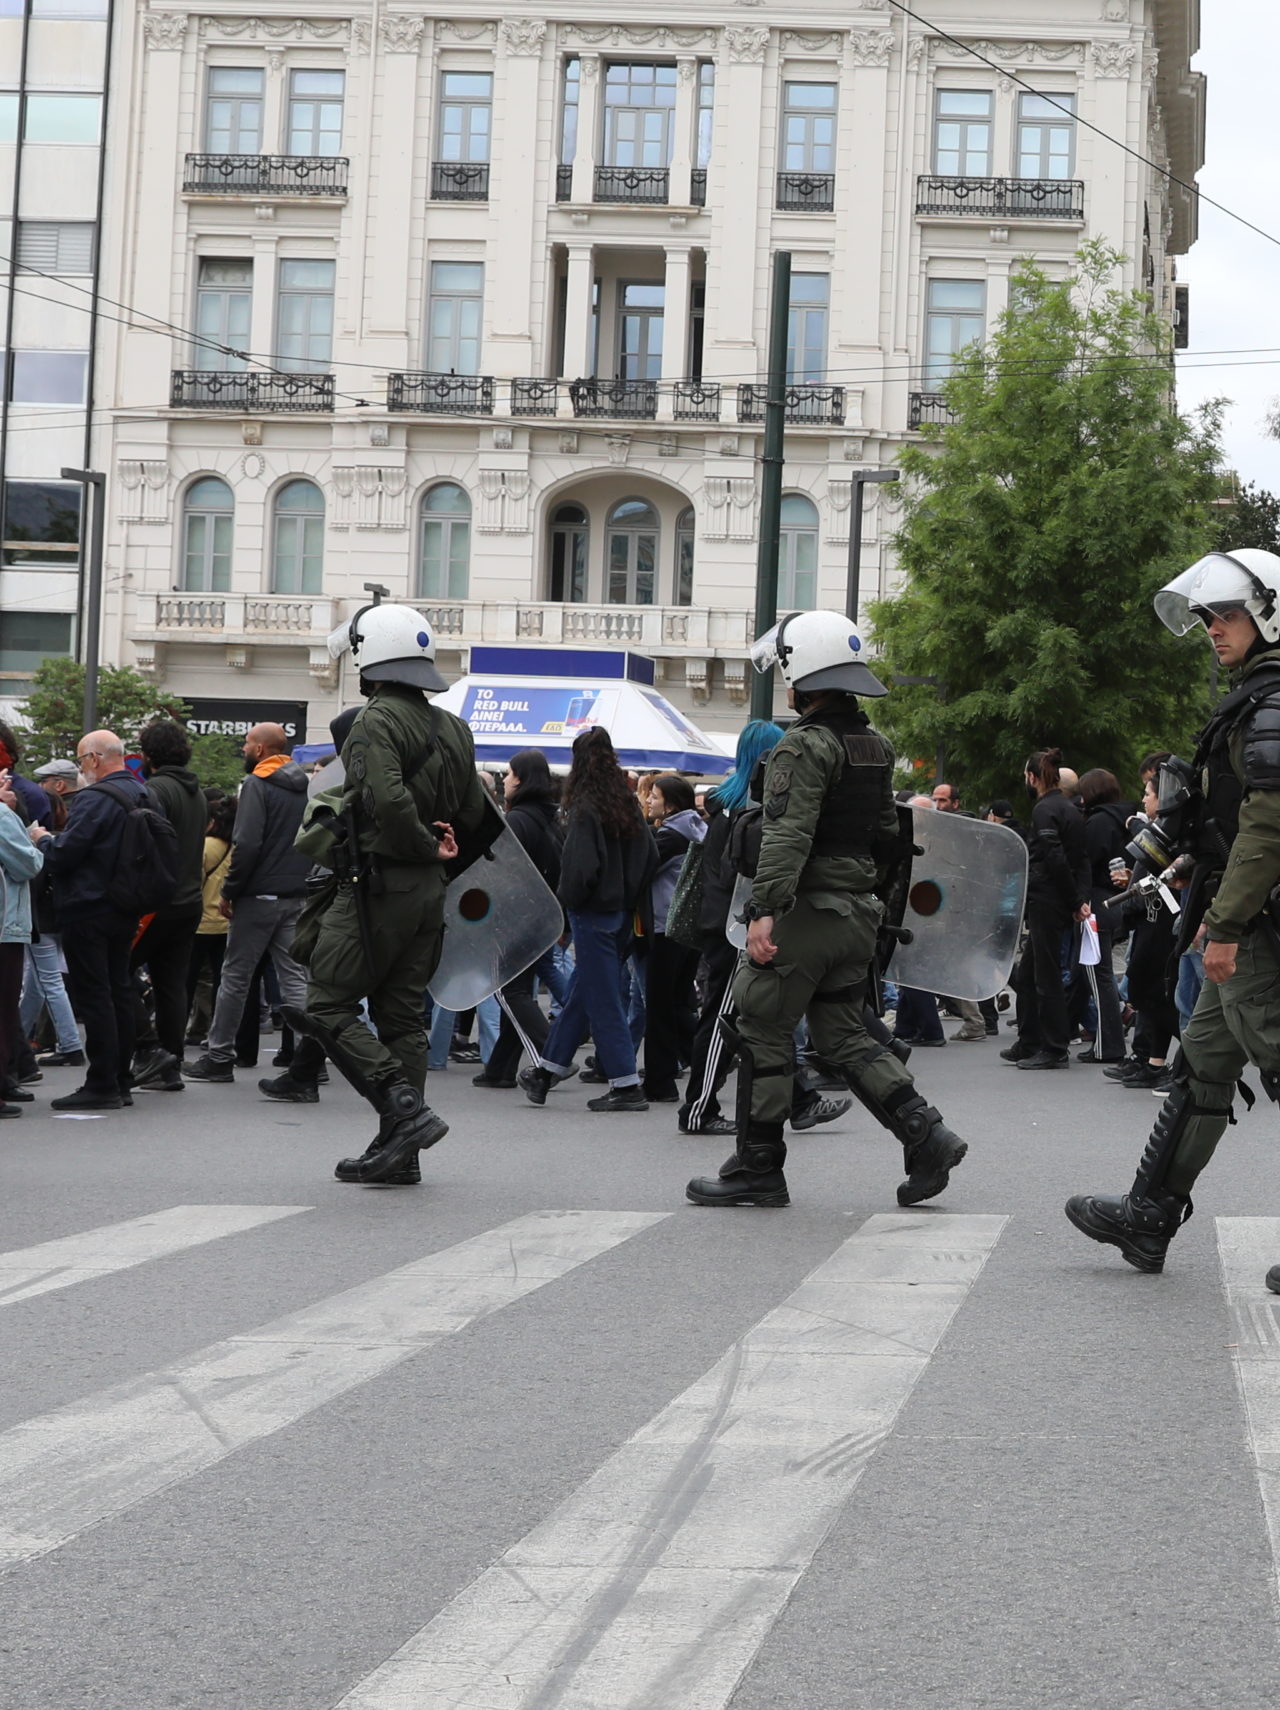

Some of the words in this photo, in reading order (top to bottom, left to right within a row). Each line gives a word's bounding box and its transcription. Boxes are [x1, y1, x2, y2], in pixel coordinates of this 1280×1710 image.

[473, 700, 499, 710] RED
[500, 701, 530, 711] BULL
[469, 710, 504, 721] ΔΙΝΕΙ
[186, 719, 297, 737] STARBS
